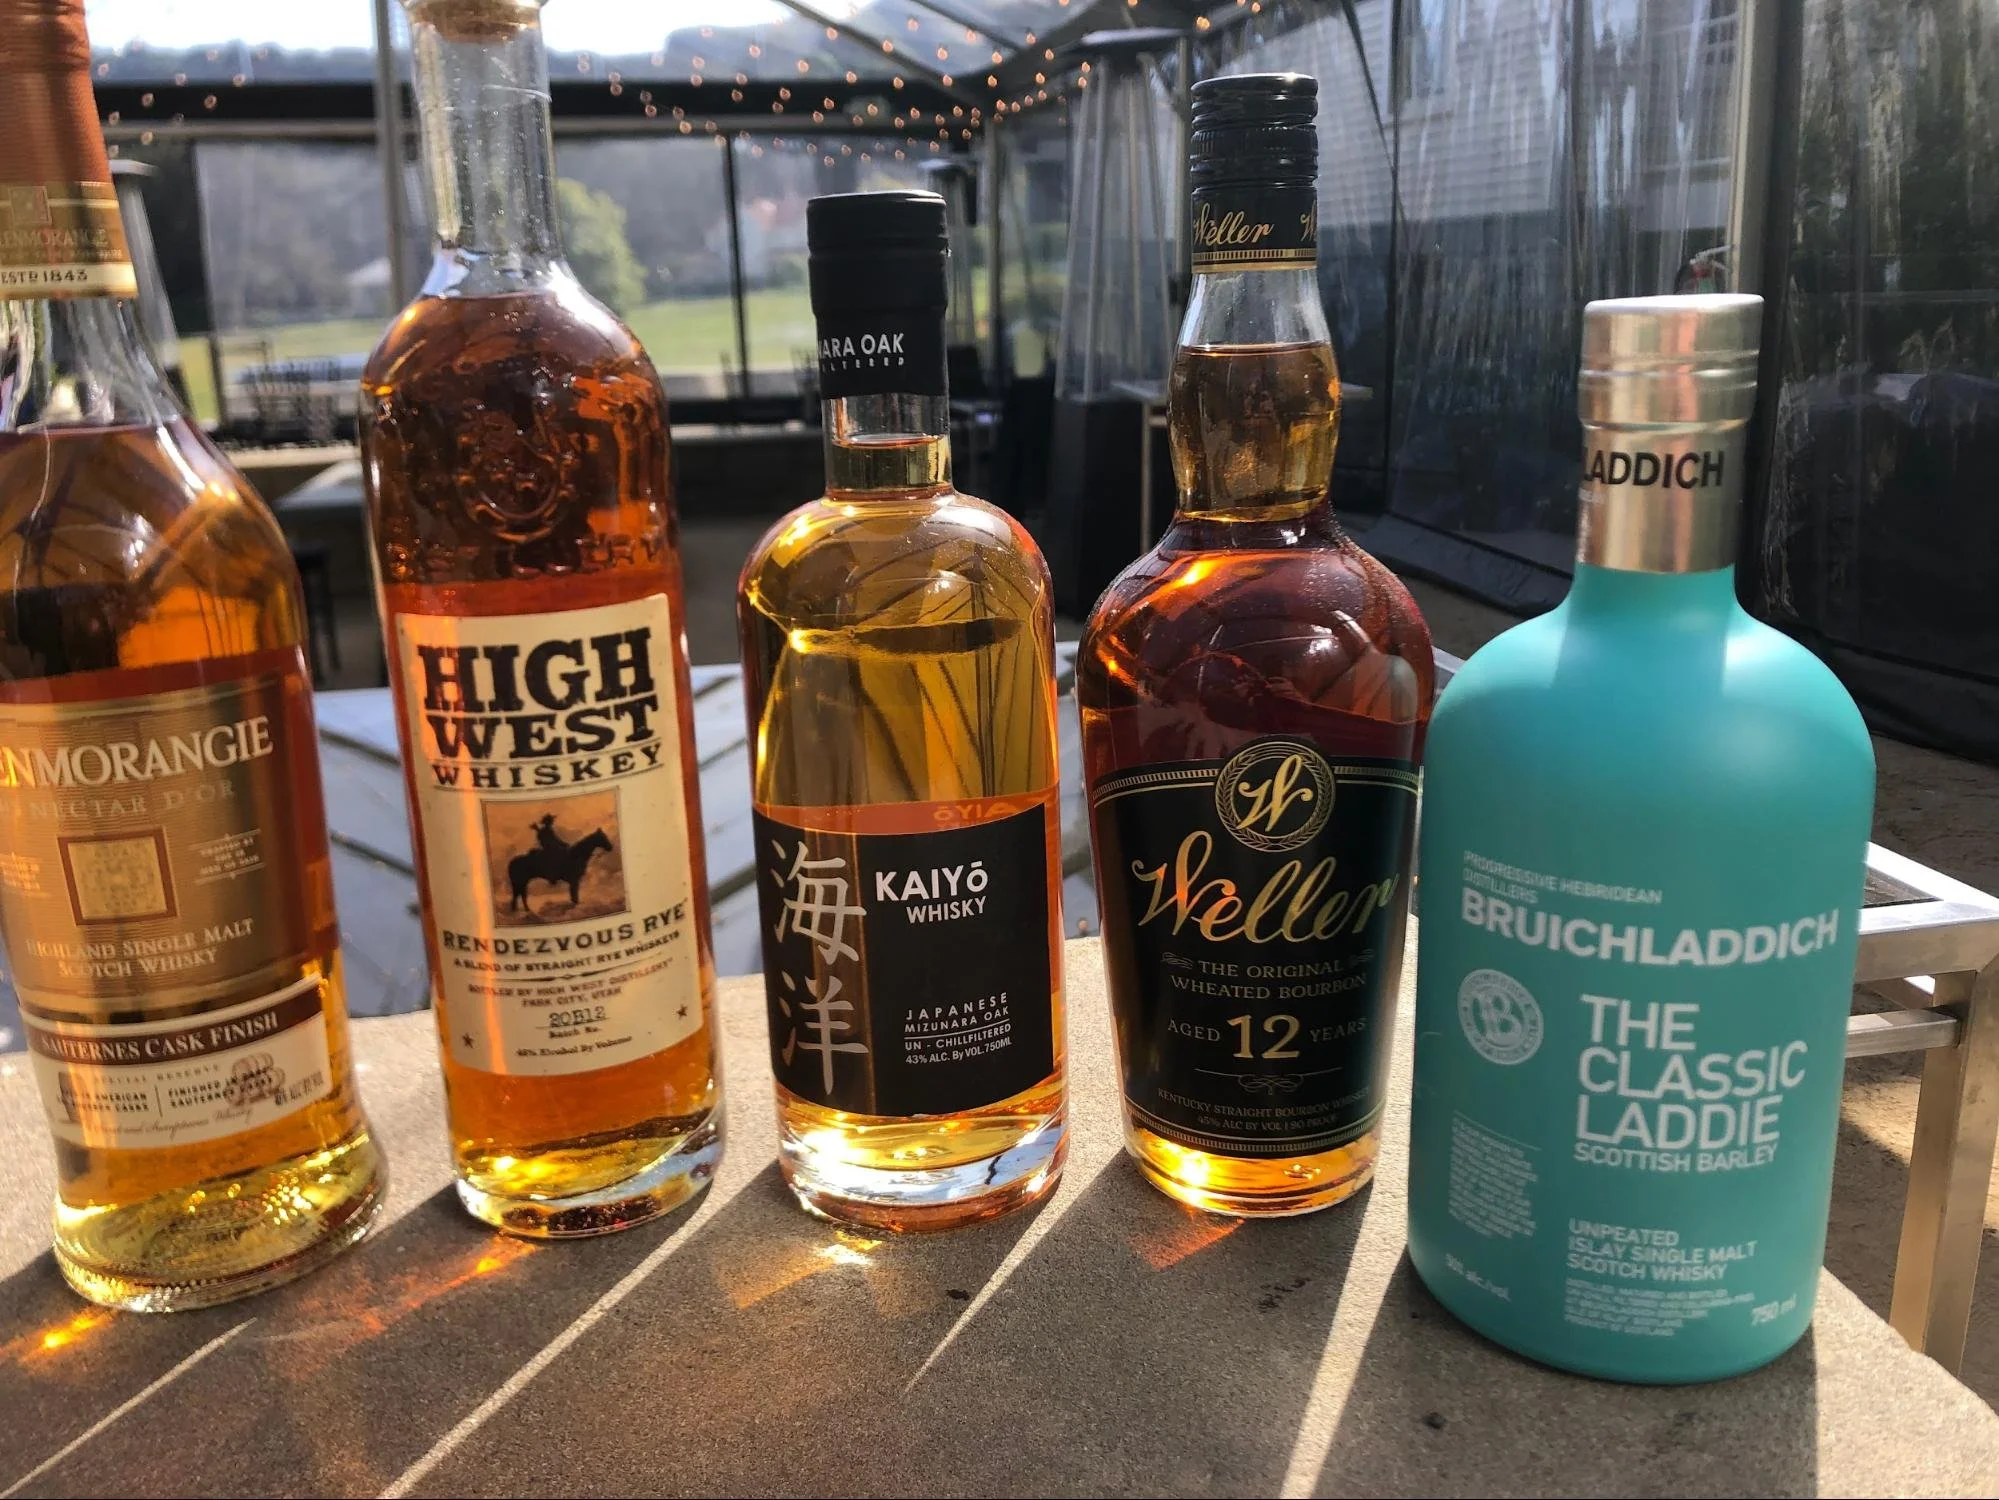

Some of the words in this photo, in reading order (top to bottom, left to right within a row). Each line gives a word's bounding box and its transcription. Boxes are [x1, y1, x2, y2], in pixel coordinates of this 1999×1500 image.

[1193, 202, 1275, 246] Weller
[43, 269, 89, 282] 1843
[819, 336, 856, 359] ARA
[860, 332, 904, 355] OAK
[417, 626, 655, 712] HIGH
[426, 693, 658, 759] WEST
[431, 742, 662, 788] WHISKEY
[30, 794, 148, 819] NECTAR
[875, 860, 989, 902] KAIYō
[1131, 830, 1400, 944] Weller
[1463, 850, 1558, 892] PROGRESSIVE
[1559, 877, 1664, 904] HEBRIDEAN
[1463, 867, 1540, 904] DISTILLERS
[906, 895, 987, 924] WHISKY
[1460, 886, 1840, 967] BRUICHLADDICH
[26, 938, 116, 959] HIGHLAND
[122, 931, 196, 957] SINGLE
[202, 917, 254, 944] MALT
[443, 924, 634, 955] RENDEZVOUS
[642, 904, 686, 934] RYE
[58, 960, 132, 978] SCOTCH
[137, 947, 219, 974] WHISKY
[463, 960, 501, 972] BLEND
[504, 963, 520, 972] OF
[526, 957, 592, 972] STRAIGHT
[596, 950, 621, 963] RYE
[624, 930, 680, 957] WHISKEYS
[770, 839, 870, 1097] 海洋
[1170, 975, 1271, 999] WHEATED
[1279, 971, 1368, 1000] BOURBON
[1197, 960, 1239, 977] THE
[1246, 959, 1343, 978] ORIGINAL
[516, 988, 532, 996] BY
[570, 980, 604, 993] WEST
[522, 998, 552, 1008] PARK
[904, 1015, 979, 1033] MIZUNARA
[983, 1006, 1009, 1021] OAK
[906, 992, 1008, 1021] JAPANESE
[1578, 993, 1701, 1051] THE
[40, 1034, 142, 1062] SAUTERNES
[144, 1031, 204, 1058] CASK
[208, 1010, 279, 1047] FINISH
[904, 1041, 922, 1051] UN
[935, 1023, 1012, 1049] CHILLFILTERED
[1167, 1017, 1221, 1042] AGED
[1226, 1014, 1301, 1060] 12
[1310, 1017, 1368, 1043] YEARS
[905, 1054, 928, 1064] 43%
[929, 1052, 951, 1063] ALC.
[952, 1050, 964, 1061] By
[1577, 1040, 1809, 1101] CLASSIC
[1157, 1087, 1211, 1113] KENTUCKY
[1214, 1104, 1273, 1118] STRAIGHT
[1275, 1100, 1331, 1117] BOURBON
[1575, 1093, 1784, 1150] LADDIE
[1573, 1141, 1691, 1173] SCOTTISH
[1696, 1142, 1779, 1173] BARLEY
[1568, 1217, 1680, 1248] UNPEATED
[1566, 1253, 1647, 1280] SCOTCH
[1651, 1262, 1729, 1282] WHISKY
[1567, 1235, 1628, 1260] ISLAY
[1630, 1245, 1705, 1266] SINGLE
[1708, 1240, 1759, 1263] MALT
